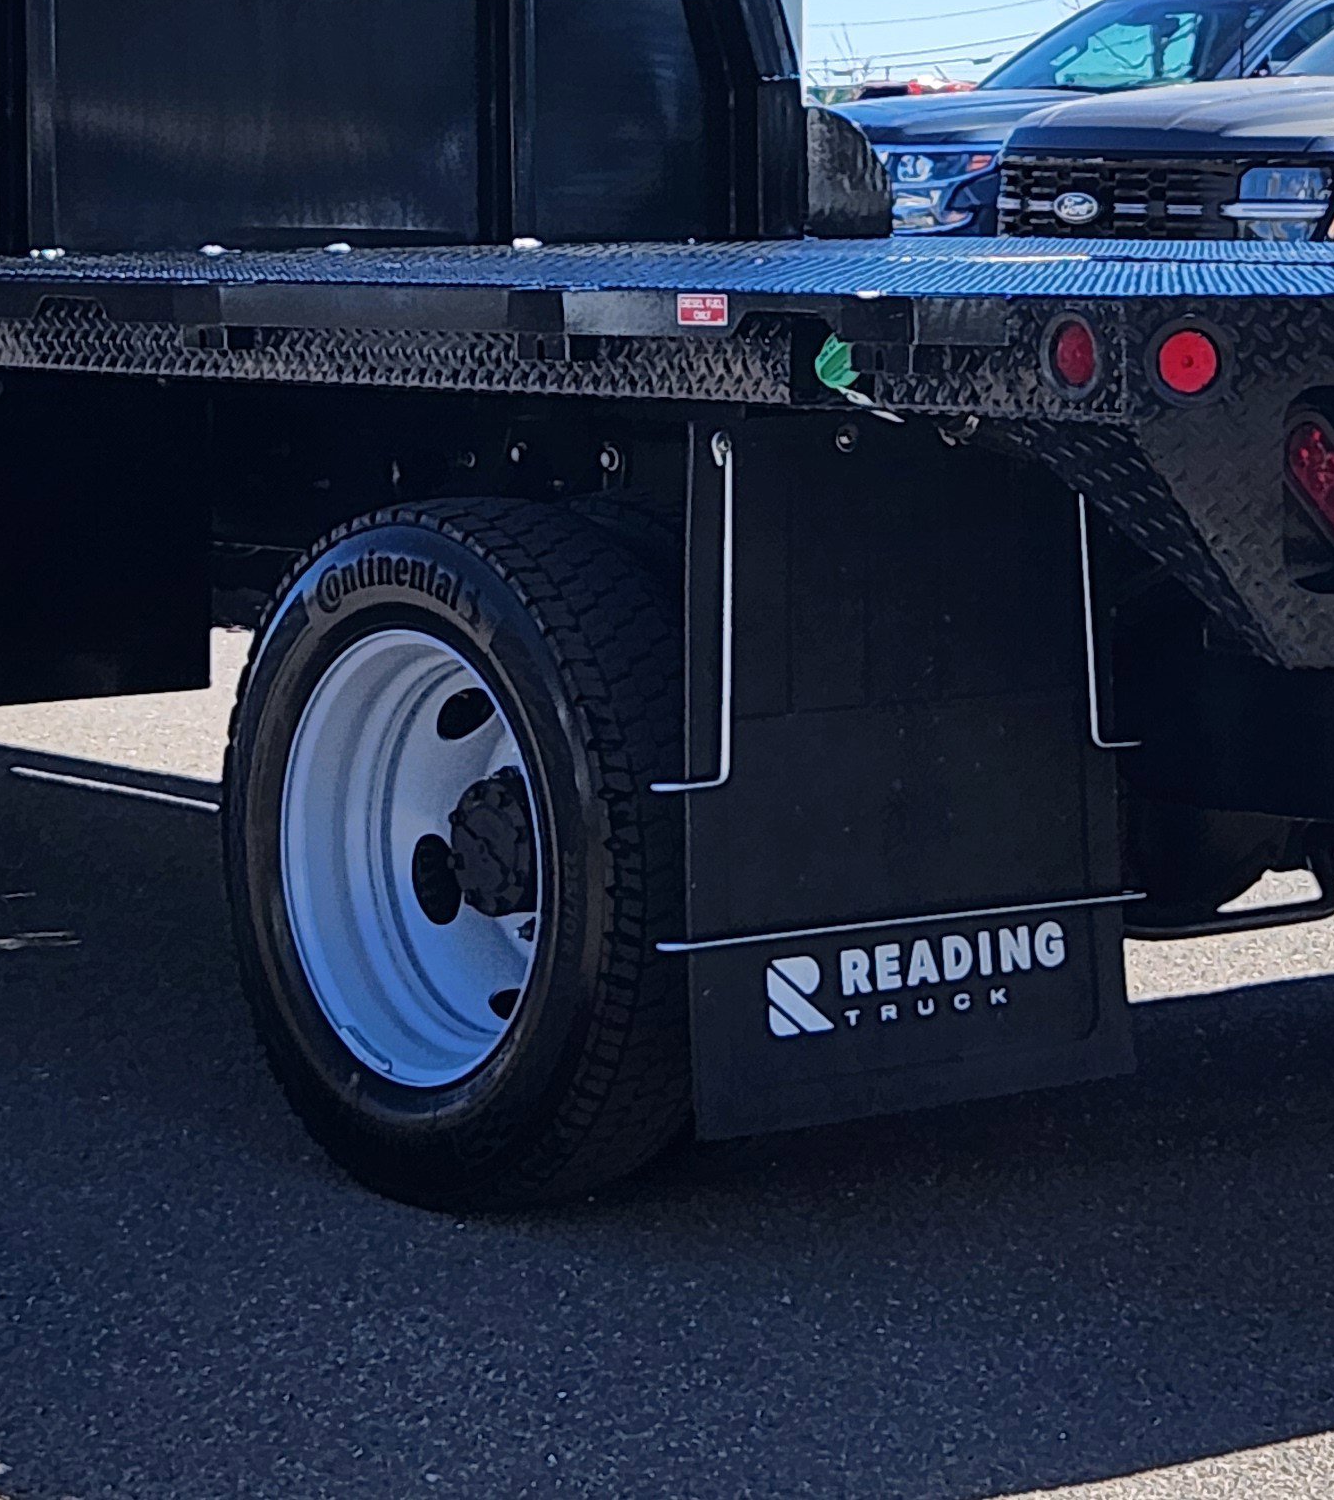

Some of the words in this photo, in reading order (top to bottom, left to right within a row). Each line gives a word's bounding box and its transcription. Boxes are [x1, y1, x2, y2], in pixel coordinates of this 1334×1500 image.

[316, 548, 464, 614] Continental
[840, 921, 1066, 996] READING
[843, 987, 1008, 1027] TRUCK
